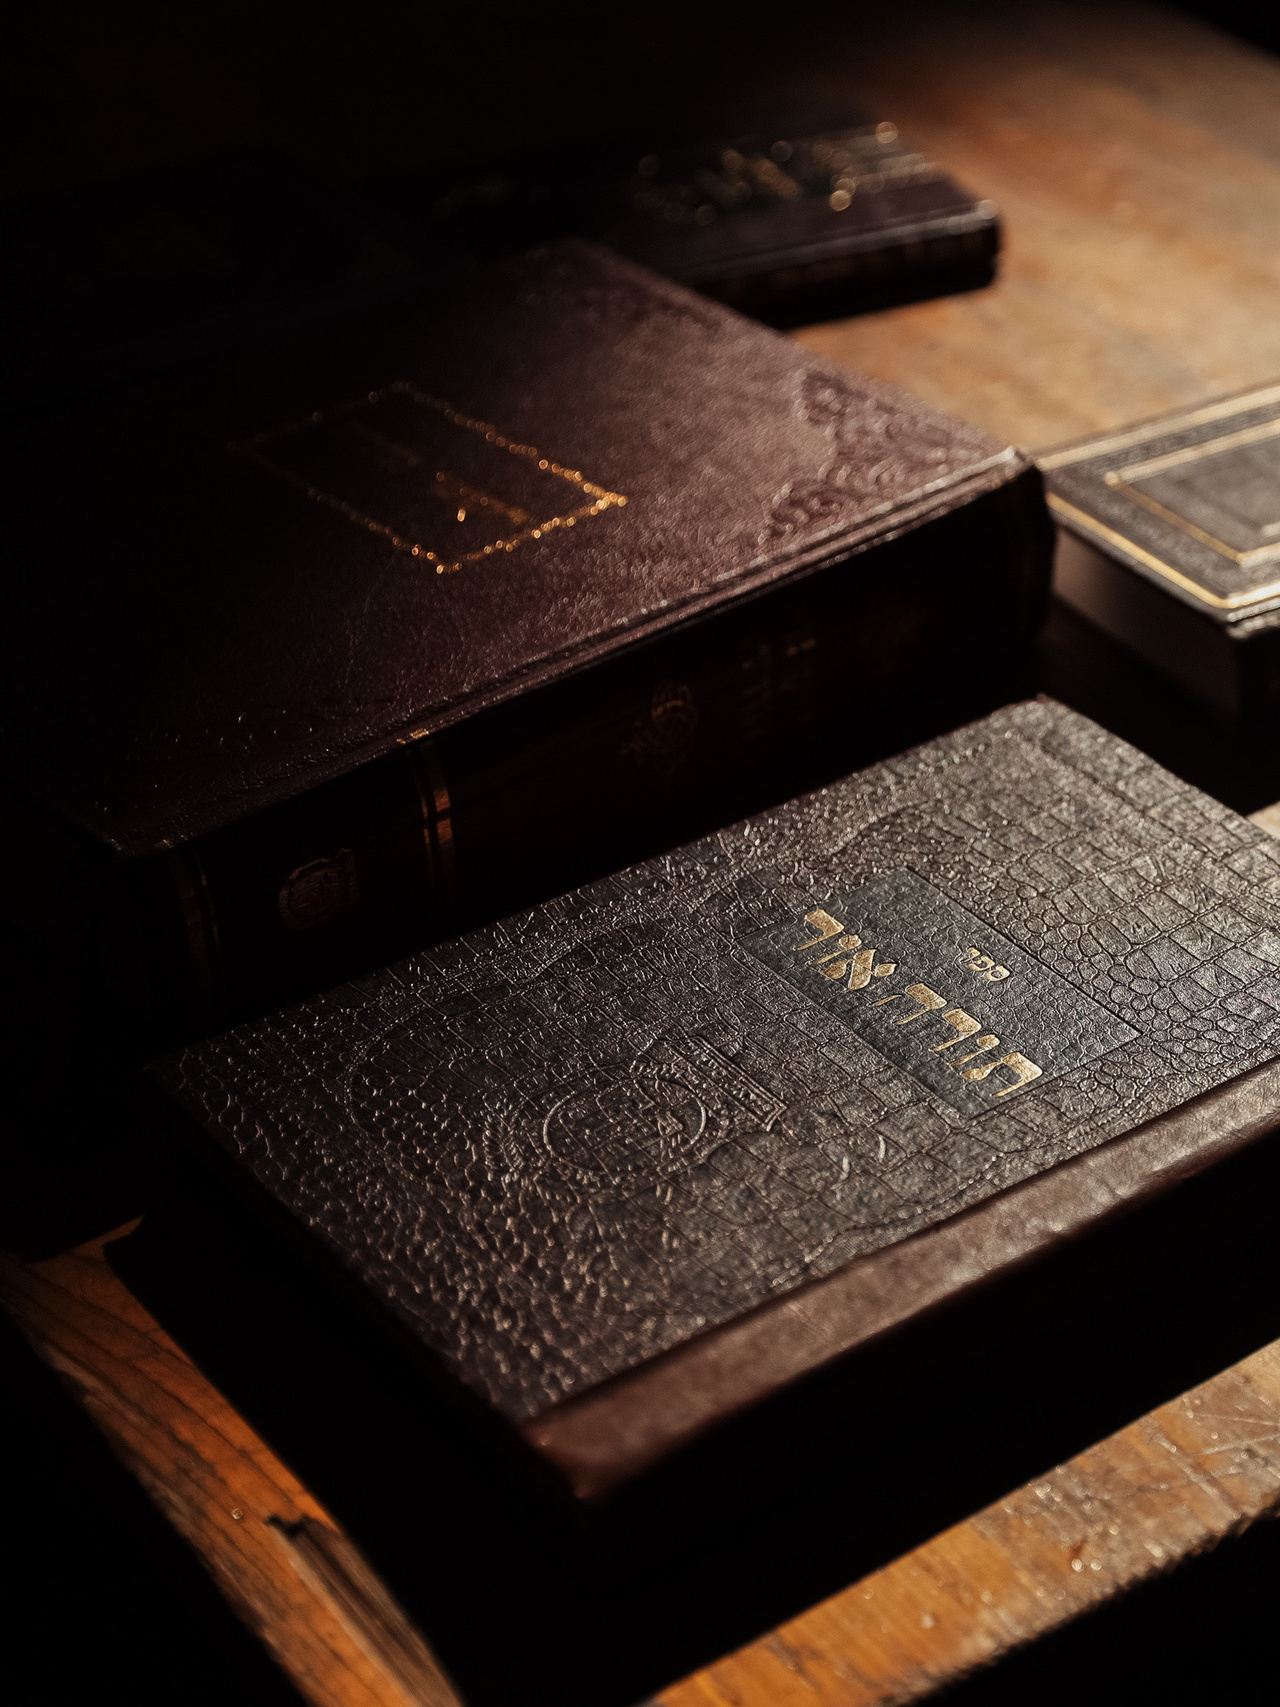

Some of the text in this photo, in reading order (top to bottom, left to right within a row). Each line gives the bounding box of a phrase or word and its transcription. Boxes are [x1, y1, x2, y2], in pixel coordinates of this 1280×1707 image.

[796, 909, 898, 991] אור
[962, 946, 1010, 982] ספר
[869, 983, 1043, 1098] תורה
